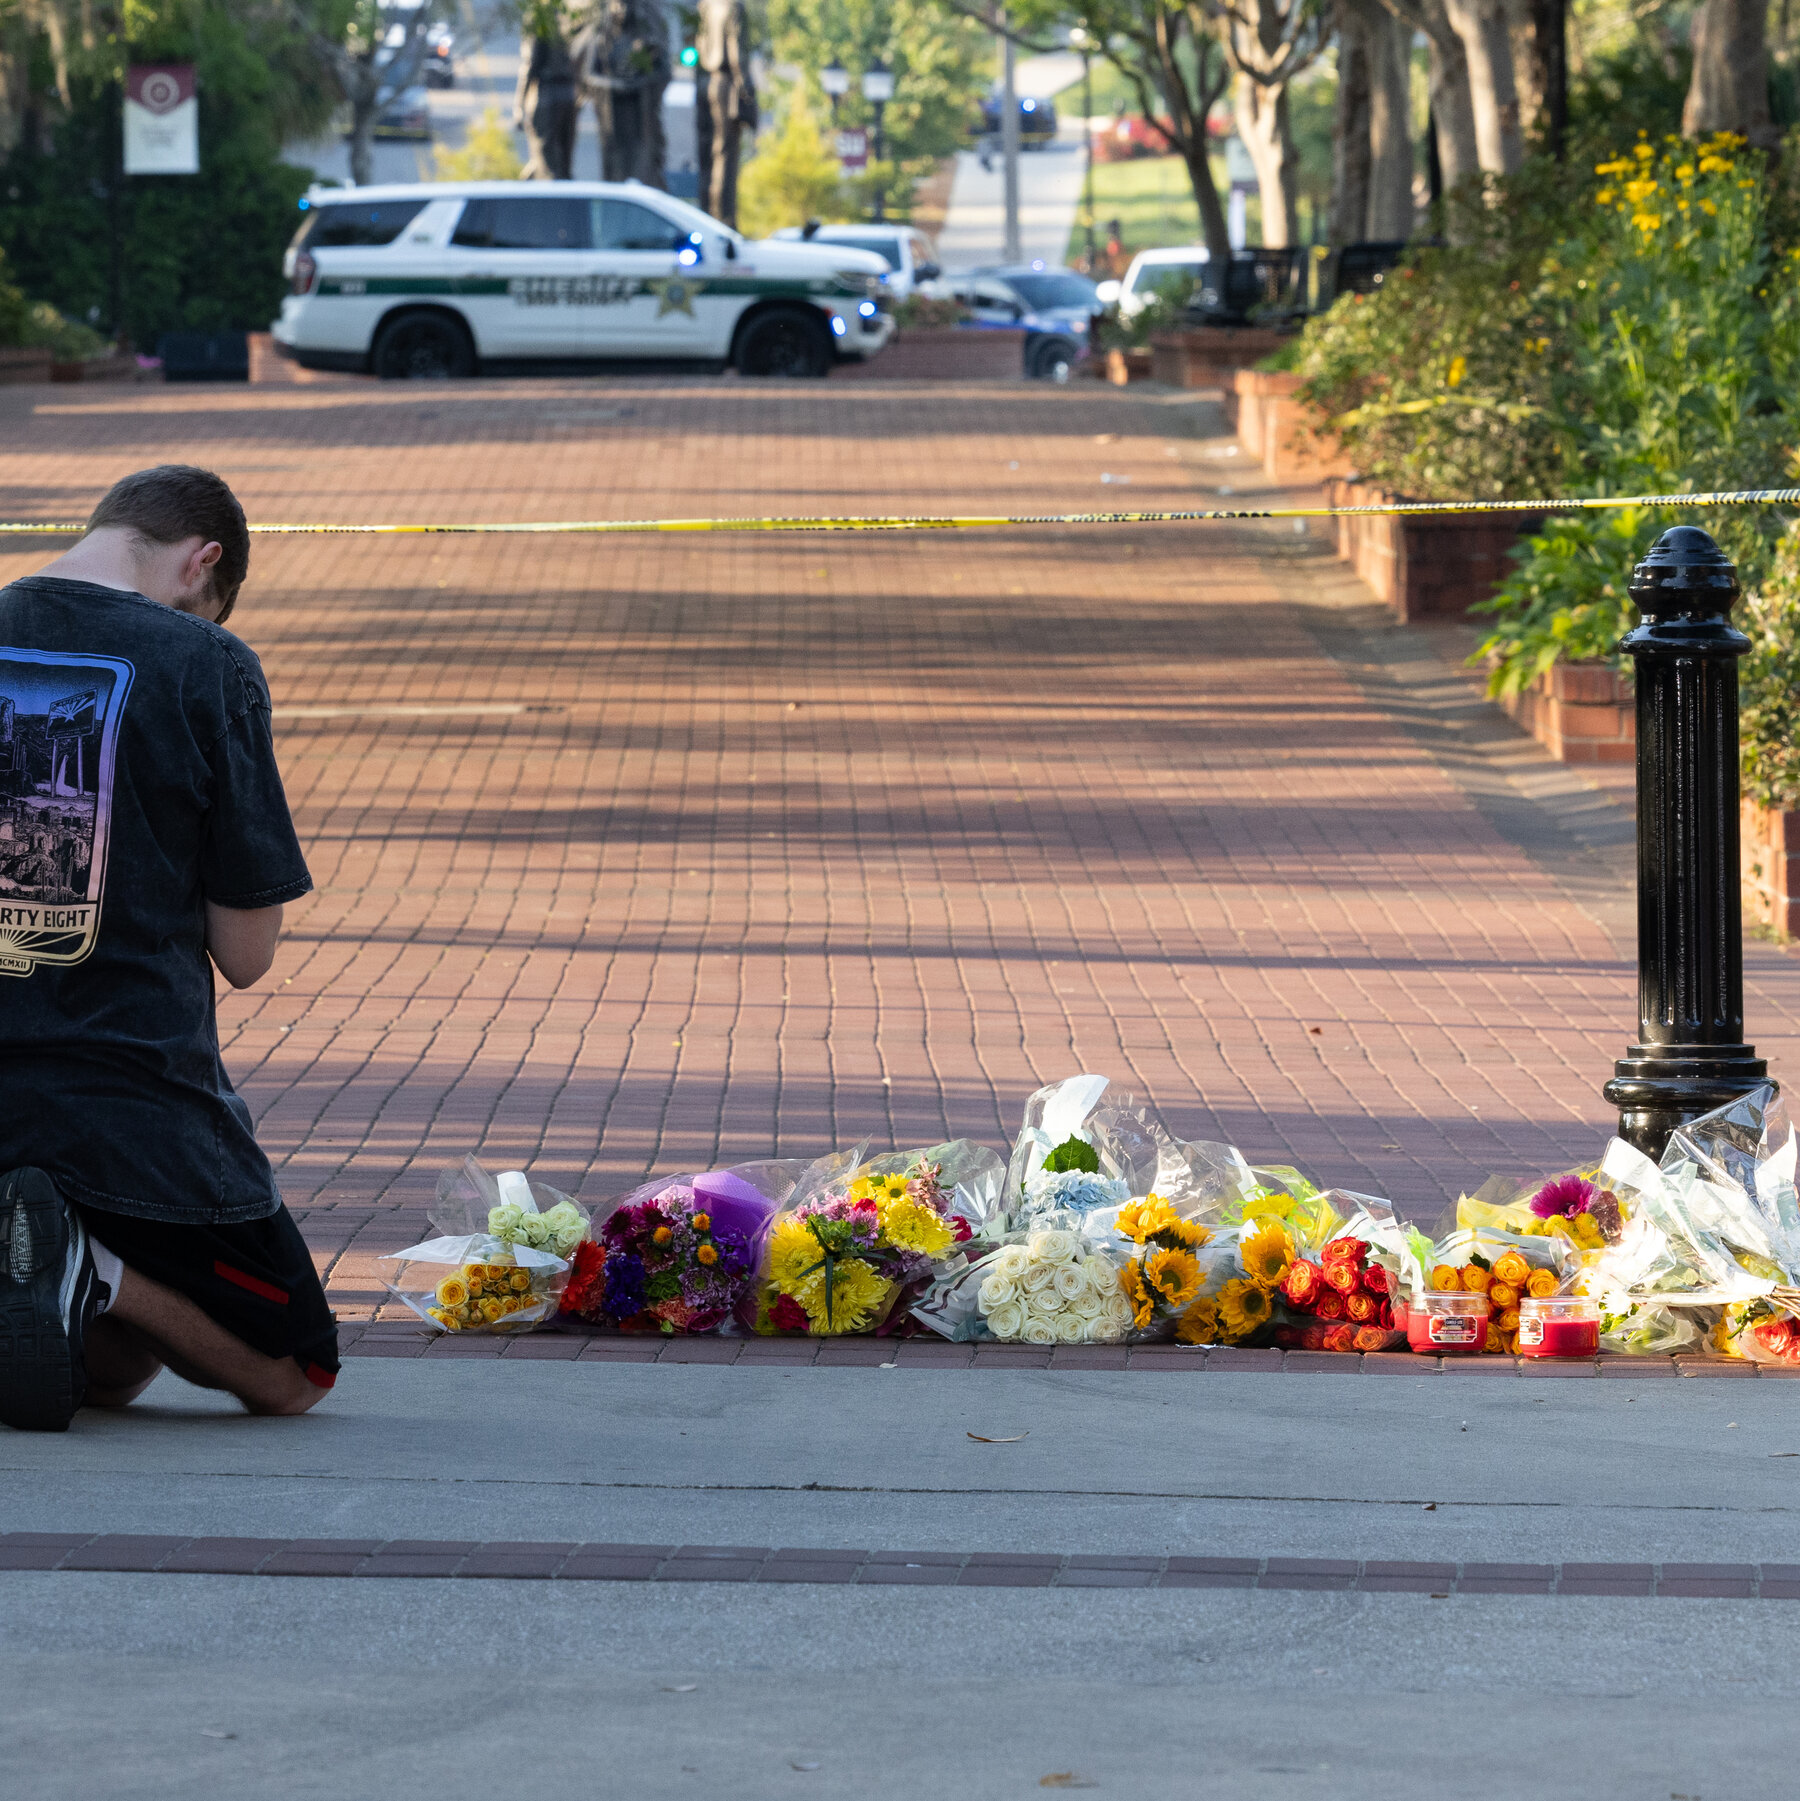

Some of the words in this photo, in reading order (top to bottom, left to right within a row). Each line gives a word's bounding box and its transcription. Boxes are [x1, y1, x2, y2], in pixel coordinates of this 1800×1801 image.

[0, 907, 40, 927] RTY
[44, 909, 90, 928] EIGHT
[0, 958, 27, 969] CMXII
